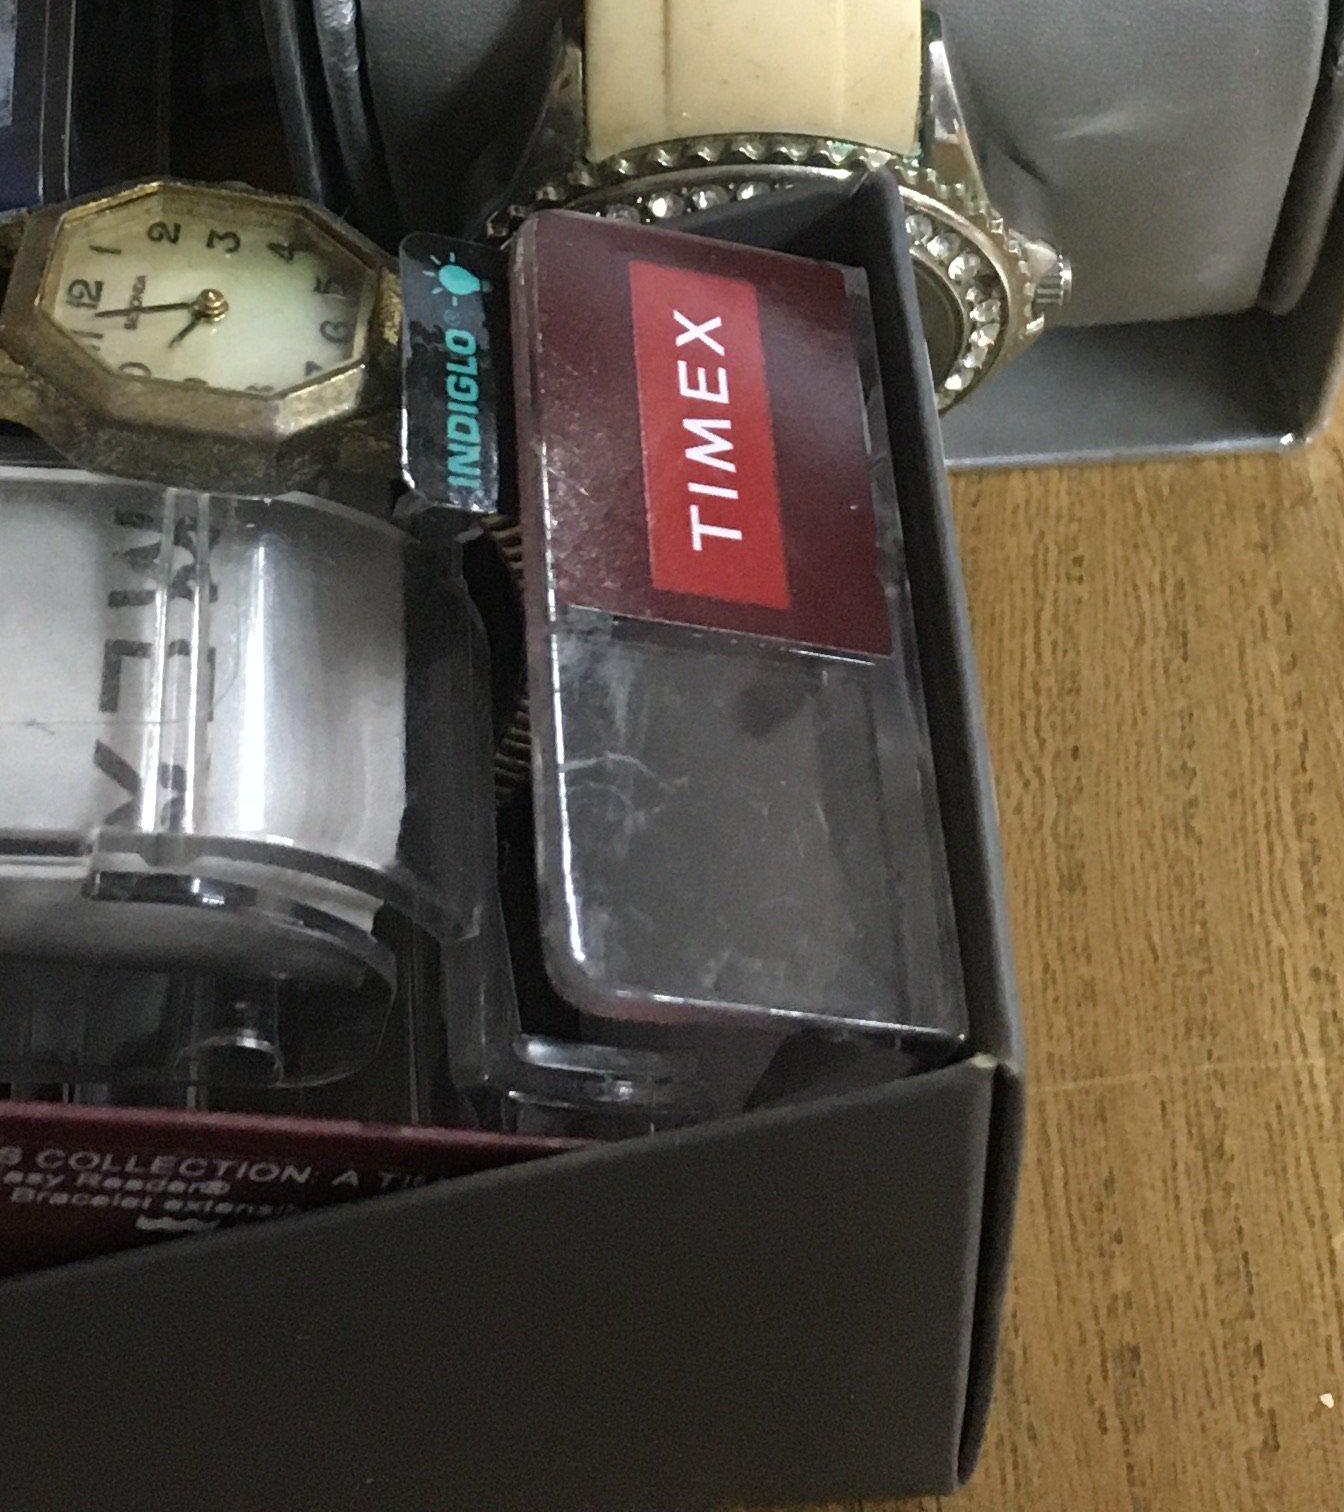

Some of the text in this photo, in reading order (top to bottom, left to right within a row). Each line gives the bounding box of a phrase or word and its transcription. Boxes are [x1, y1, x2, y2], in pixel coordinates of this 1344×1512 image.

[146, 220, 182, 246] 2
[206, 229, 242, 255] 3
[672, 309, 744, 552] TIMEX
[331, 1168, 360, 1187] A
